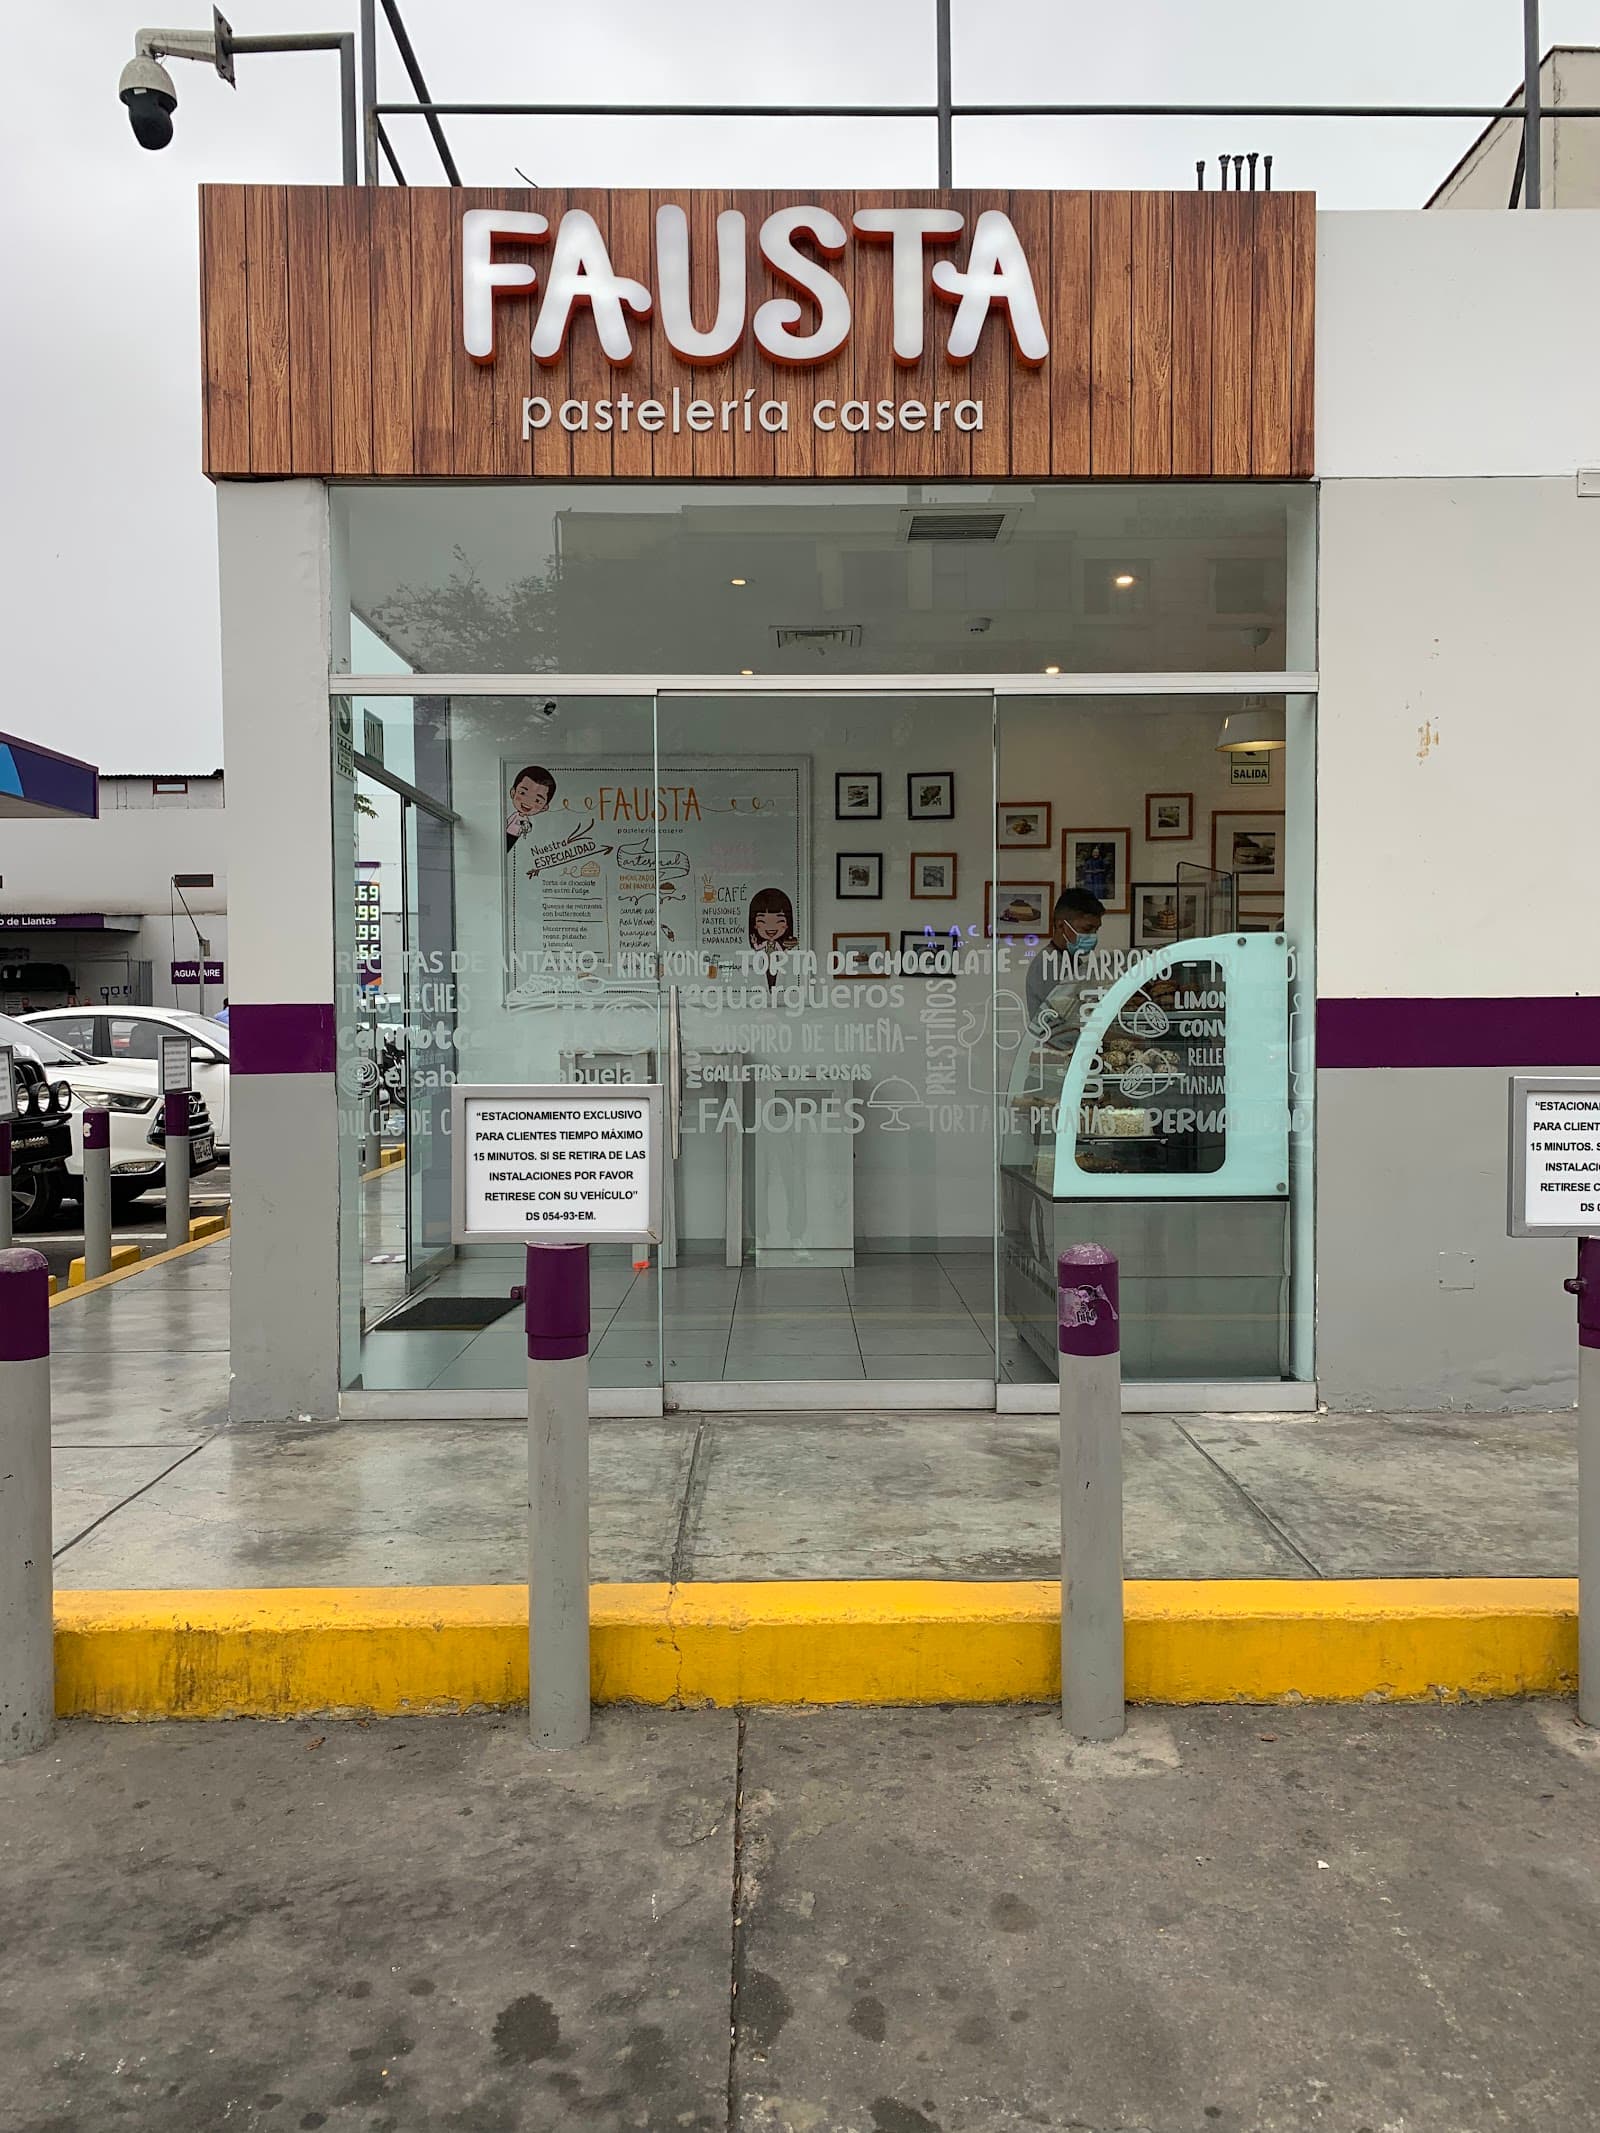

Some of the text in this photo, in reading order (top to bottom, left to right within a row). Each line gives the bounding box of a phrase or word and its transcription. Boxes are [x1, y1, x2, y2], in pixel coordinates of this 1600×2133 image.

[462, 204, 1050, 367] FAUSTA
[521, 387, 984, 441] pastelería casera
[1233, 769, 1267, 779] SALIDA
[600, 787, 702, 822] FAUSTA
[530, 840, 568, 857] Nuestra
[534, 841, 596, 869] ESPECIALIDAD
[717, 884, 748, 902] CAFÉ
[7, 917, 19, 926] de
[21, 917, 57, 926] Llantas
[451, 951, 488, 974] DE
[617, 951, 657, 978] KING
[663, 950, 712, 978] KONG
[736, 949, 818, 977] TORTA
[826, 949, 862, 977] DE
[867, 948, 1012, 976] CHOCOLATE
[1042, 949, 1173, 982] MACARRONS
[203, 969, 221, 977] AIRE
[337, 982, 472, 1014] TRES LECHES
[702, 976, 905, 1018] guargüeros
[711, 1022, 793, 1054] SUSPIRO
[801, 1023, 825, 1053] DE
[920, 979, 957, 1096] PRESTIÑOS
[384, 1059, 405, 1087] el
[702, 1063, 872, 1083] GALLETAS DE ROSAS
[1535, 1101, 1600, 1111] “ESTACIONA
[338, 1108, 403, 1137] DULCES
[411, 1108, 433, 1137] DE
[583, 1110, 642, 1120] EXCLUSIVO
[926, 1104, 994, 1134] TORTA
[999, 1105, 1022, 1135] DE
[1533, 1122, 1561, 1131] PARA
[476, 1128, 643, 1141] PARA CLIENTES TIEMPO MÁXIMO
[1531, 1142, 1542, 1151] 15
[1544, 1142, 1593, 1151] MINUTOS.
[474, 1150, 646, 1161] 15 MINUTOS. SI SE RETIRA DE LAS
[1545, 1162, 1600, 1171] INSTALACI
[489, 1170, 634, 1181] INSTALACIONES POR FAVOR
[1540, 1182, 1591, 1191] RETIRESE
[485, 1192, 536, 1201] RETIRESE
[538, 1191, 561, 1201] CON
[563, 1191, 578, 1200] SU
[1580, 1203, 1595, 1211] DS
[525, 1210, 596, 1221] DS 054-93-EM.
